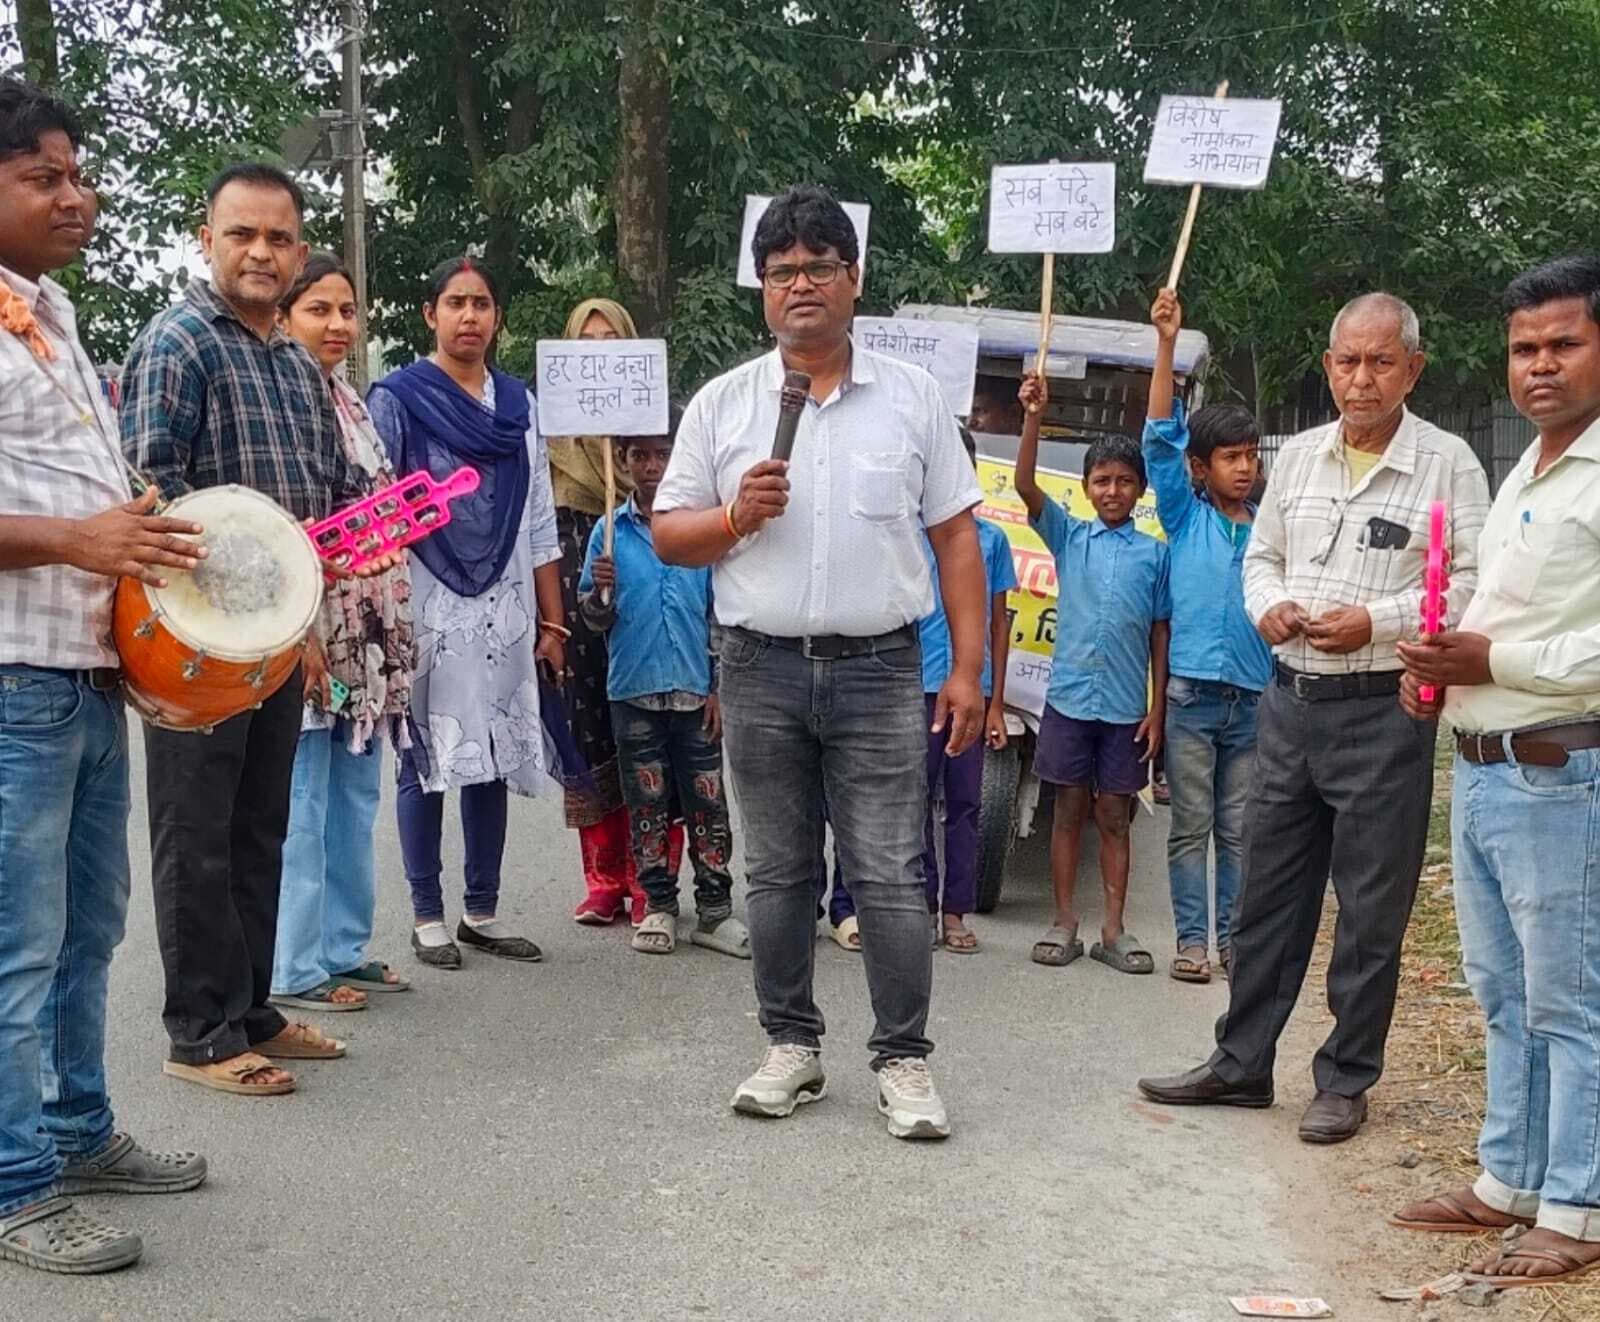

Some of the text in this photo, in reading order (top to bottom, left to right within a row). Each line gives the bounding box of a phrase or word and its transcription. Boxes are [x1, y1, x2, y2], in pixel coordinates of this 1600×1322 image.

[1167, 99, 1230, 128] विशेष
[1184, 147, 1269, 175] अभियान
[1001, 177, 1046, 208] सब
[1034, 210, 1069, 237] सब
[544, 354, 658, 386] हर घर बच्चा
[577, 380, 658, 416] स्कूल मे
